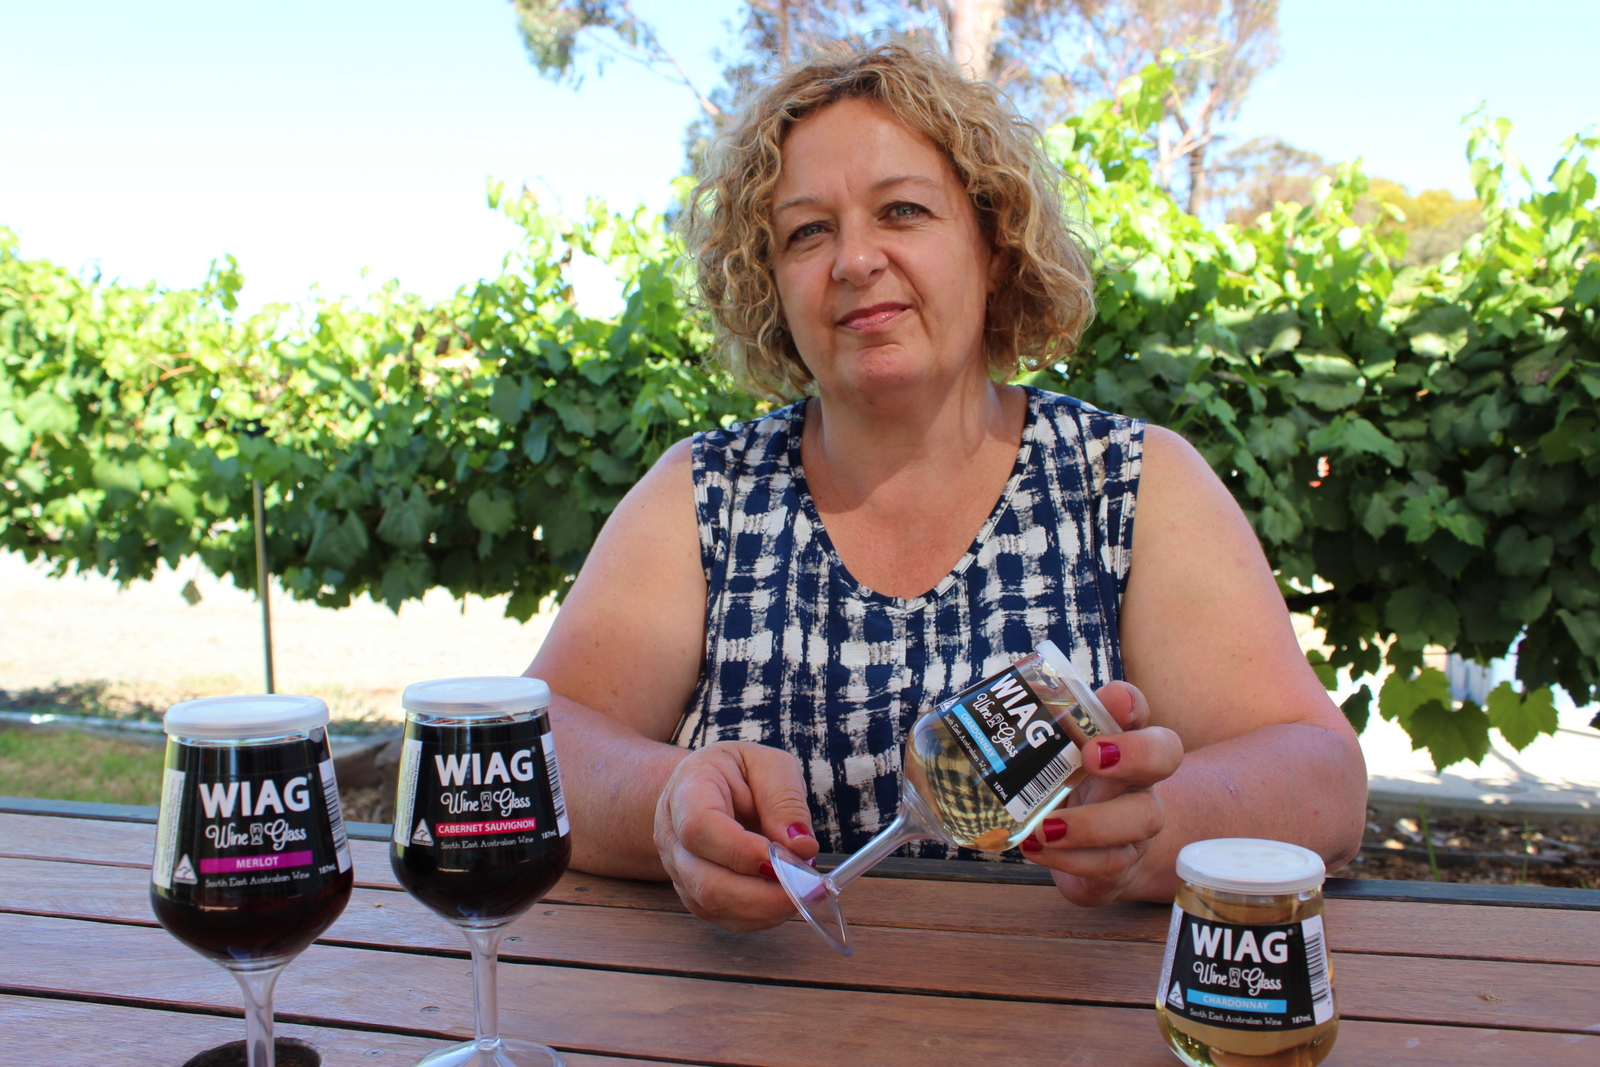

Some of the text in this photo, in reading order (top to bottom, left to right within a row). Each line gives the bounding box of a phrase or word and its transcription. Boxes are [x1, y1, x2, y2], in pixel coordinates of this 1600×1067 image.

[990, 673, 1055, 749] WIAG
[961, 713, 996, 758] CHARDONNAY
[973, 693, 995, 719] Wine
[991, 722, 1018, 757] Glass
[951, 723, 961, 736] East
[959, 735, 979, 762] Australian
[978, 760, 989, 776] Wine
[434, 749, 534, 787] WIAG
[199, 776, 311, 819] WIAG
[440, 790, 479, 814] Wine
[493, 788, 531, 817] Glass
[993, 781, 1009, 801] 187mL
[205, 823, 249, 849] Wine
[264, 818, 307, 851] Glass
[438, 820, 535, 835] CABERNET SAUVIGNON
[541, 829, 557, 840] 187mL
[440, 838, 461, 850] South
[462, 838, 478, 849] East
[480, 836, 517, 848] Australian
[518, 836, 534, 844] Wine
[236, 856, 279, 869] MERLOT
[318, 864, 336, 875] 187mL
[205, 876, 228, 888] South
[228, 875, 247, 887] East
[249, 873, 291, 886] Australian
[291, 870, 310, 881] Wine
[1191, 922, 1288, 964] WIAG
[1193, 961, 1228, 985] Wine
[1241, 967, 1282, 996] Glass
[1203, 995, 1269, 1010] CHARDONNAY
[1189, 1007, 1283, 1026] South East Australian Wine
[1292, 1015, 1312, 1024] 187mL
